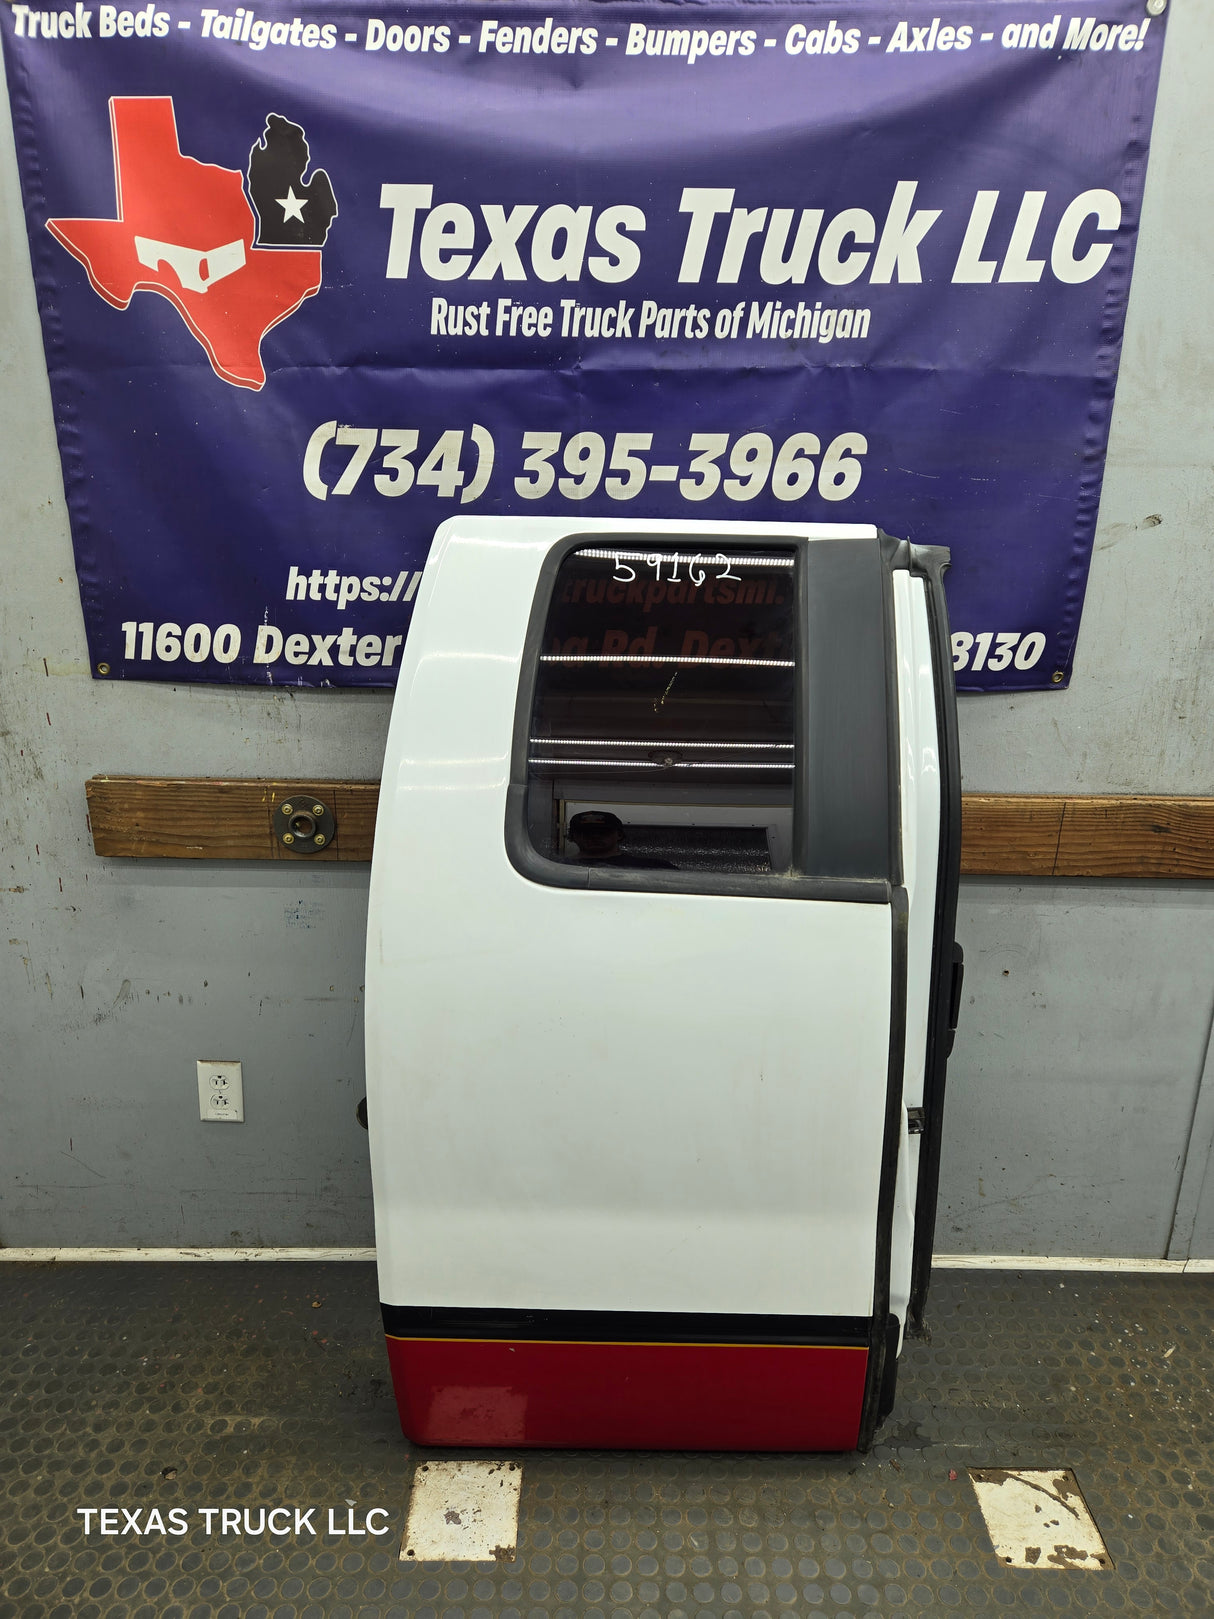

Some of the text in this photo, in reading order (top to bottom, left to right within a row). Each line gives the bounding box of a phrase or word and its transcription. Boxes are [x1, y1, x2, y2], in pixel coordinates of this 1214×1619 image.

[12, 3, 92, 38] Truck
[100, 3, 171, 37] Beds
[201, 8, 337, 51] Tailgates
[365, 19, 450, 52] Doors
[479, 18, 598, 54] Fenders
[626, 24, 757, 64] Bumpers
[785, 21, 861, 55] Cabs
[886, 18, 973, 52] Axles
[1002, 15, 1060, 48] and
[1063, 17, 1150, 51] More!
[380, 181, 1121, 285] Texas Truck LLC
[431, 298, 871, 343] Rust Free Truck Parts of Michigan
[303, 421, 867, 503] (734) 395-3966
[286, 567, 423, 610] https://
[613, 552, 742, 587] 59162
[122, 622, 241, 663] 11600
[253, 625, 403, 668] Dexter
[598, 625, 664, 668] Rd.
